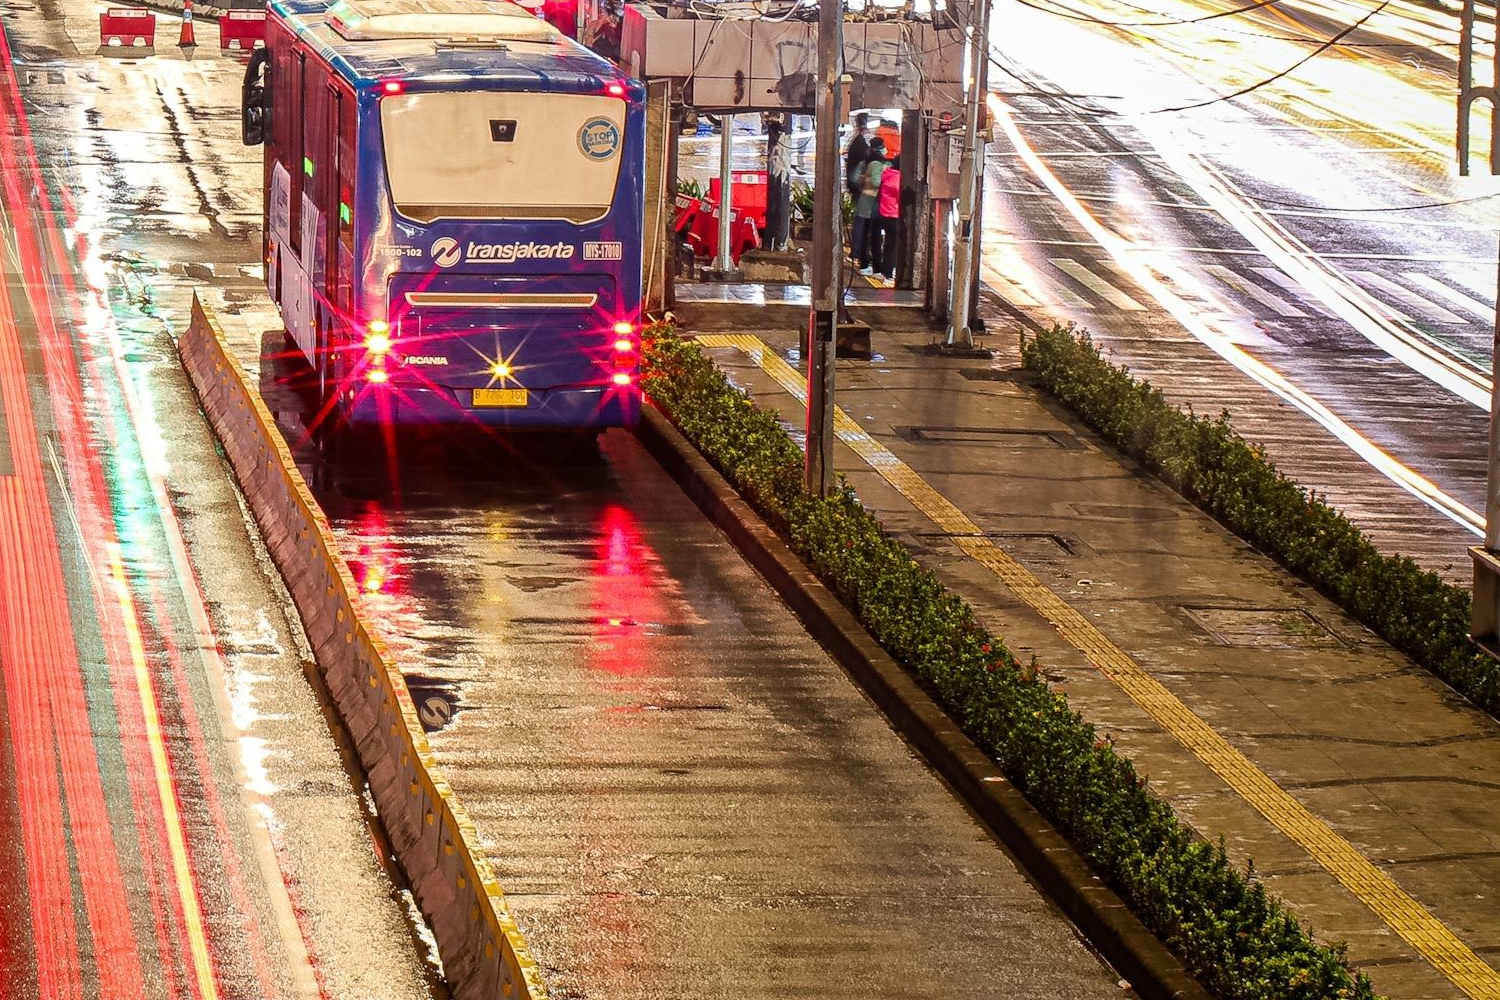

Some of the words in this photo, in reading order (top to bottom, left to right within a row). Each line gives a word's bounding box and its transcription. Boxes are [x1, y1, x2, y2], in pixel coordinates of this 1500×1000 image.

[587, 131, 612, 142] STOP
[381, 248, 422, 257] 1500-102
[465, 241, 575, 263] transjakarta
[409, 355, 448, 366] SCANIA
